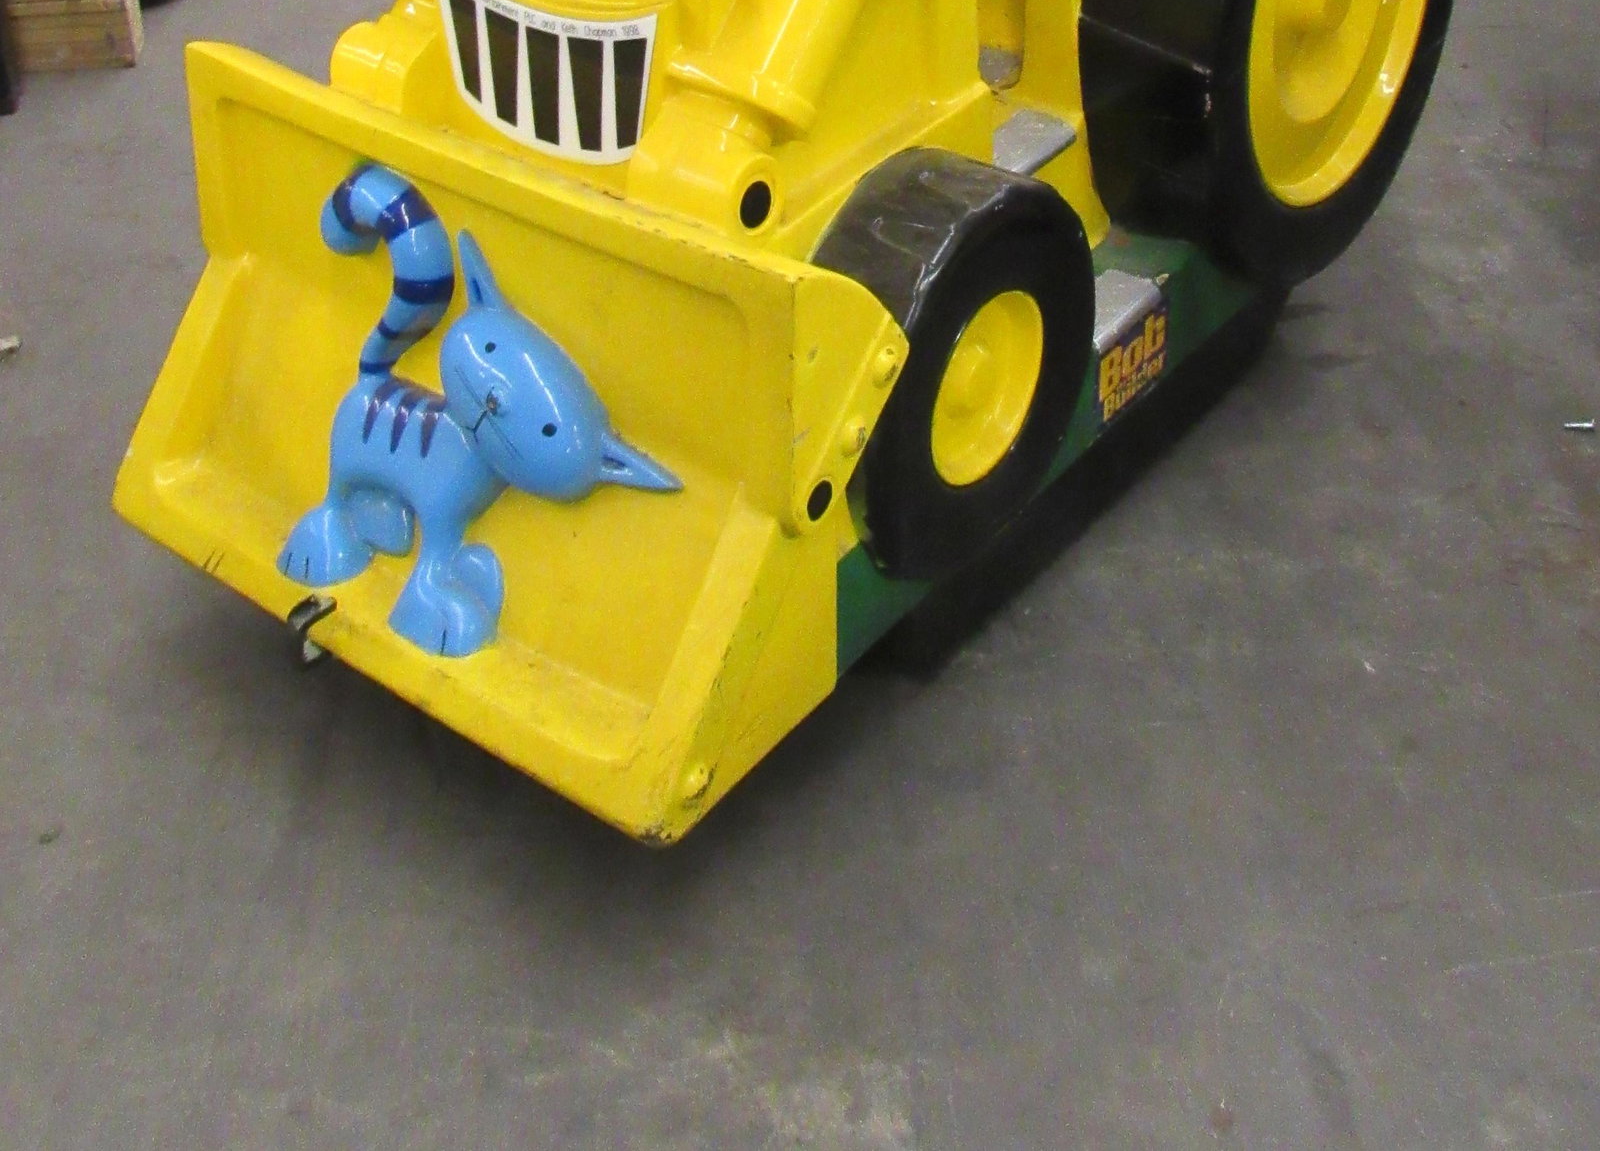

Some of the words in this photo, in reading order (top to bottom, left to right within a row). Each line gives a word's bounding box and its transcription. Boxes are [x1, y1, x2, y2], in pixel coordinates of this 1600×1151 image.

[541, 19, 556, 31] and
[561, 21, 578, 34] Keith
[583, 25, 618, 39] Chapman
[1099, 313, 1167, 403] Bob
